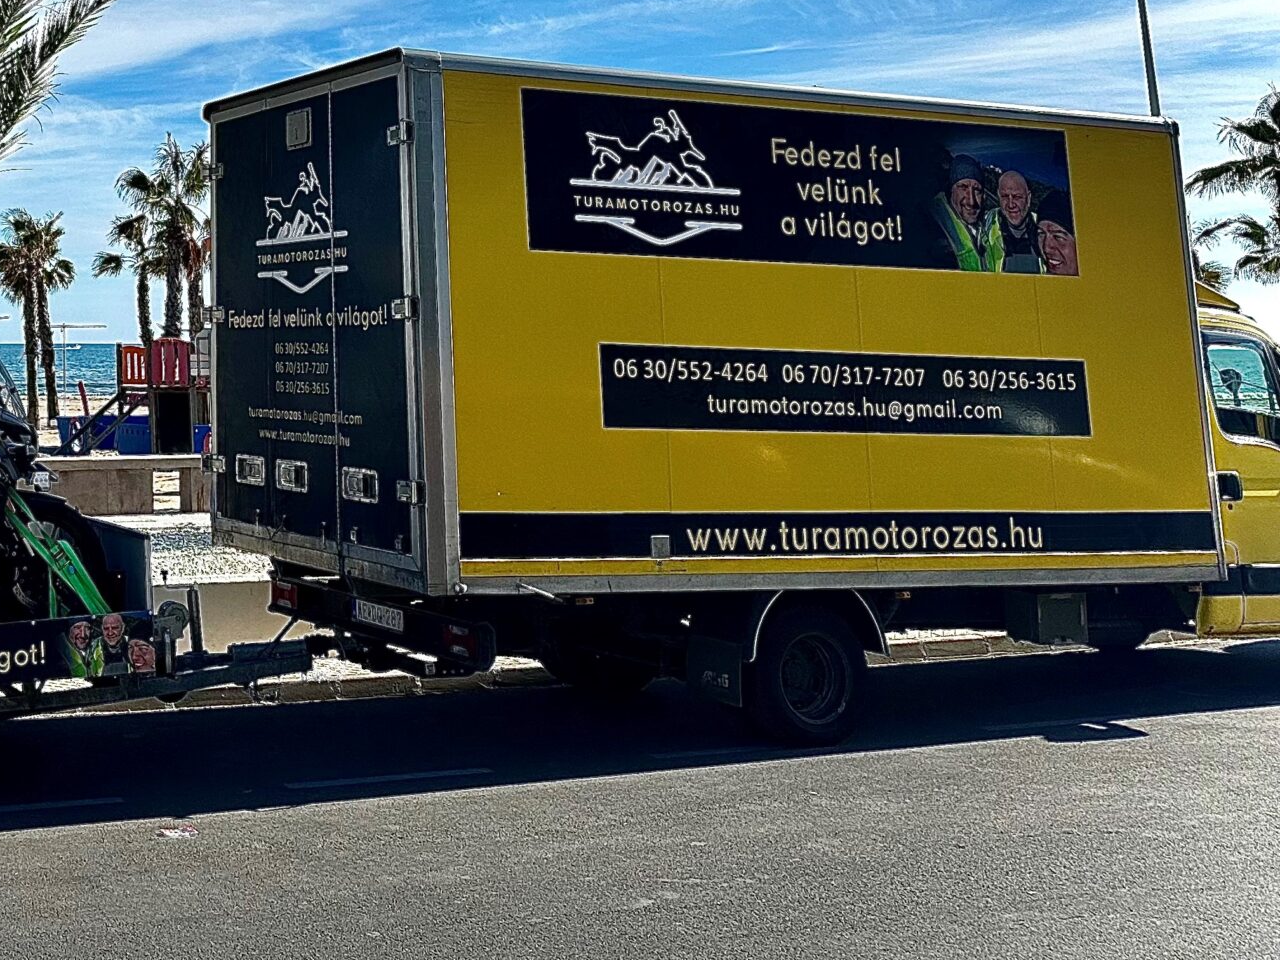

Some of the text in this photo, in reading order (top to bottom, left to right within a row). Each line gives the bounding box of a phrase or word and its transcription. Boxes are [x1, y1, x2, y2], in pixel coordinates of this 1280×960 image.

[771, 137, 900, 172] Fedezd fel
[797, 176, 883, 205] velünk
[573, 195, 740, 216] TURAMOTOROZAS.HU
[781, 211, 902, 246] a világot!
[257, 247, 347, 265] TURAMOTOROZASHU
[228, 308, 265, 329] Fedezd
[268, 308, 281, 328] fel
[284, 307, 323, 328] velünk
[337, 304, 388, 331] világot!
[275, 342, 329, 356] 06 30/552-4264
[275, 361, 329, 375] 06 70/317-7207
[613, 358, 1077, 392] 06 30/552-4264 06 70/317-7207 06 30/256-3615
[706, 394, 1003, 422] turamotorozas.hu@gmail.com
[259, 428, 351, 447] www.turamotorozashu
[686, 516, 1044, 551] www.turamotorozas.hu
